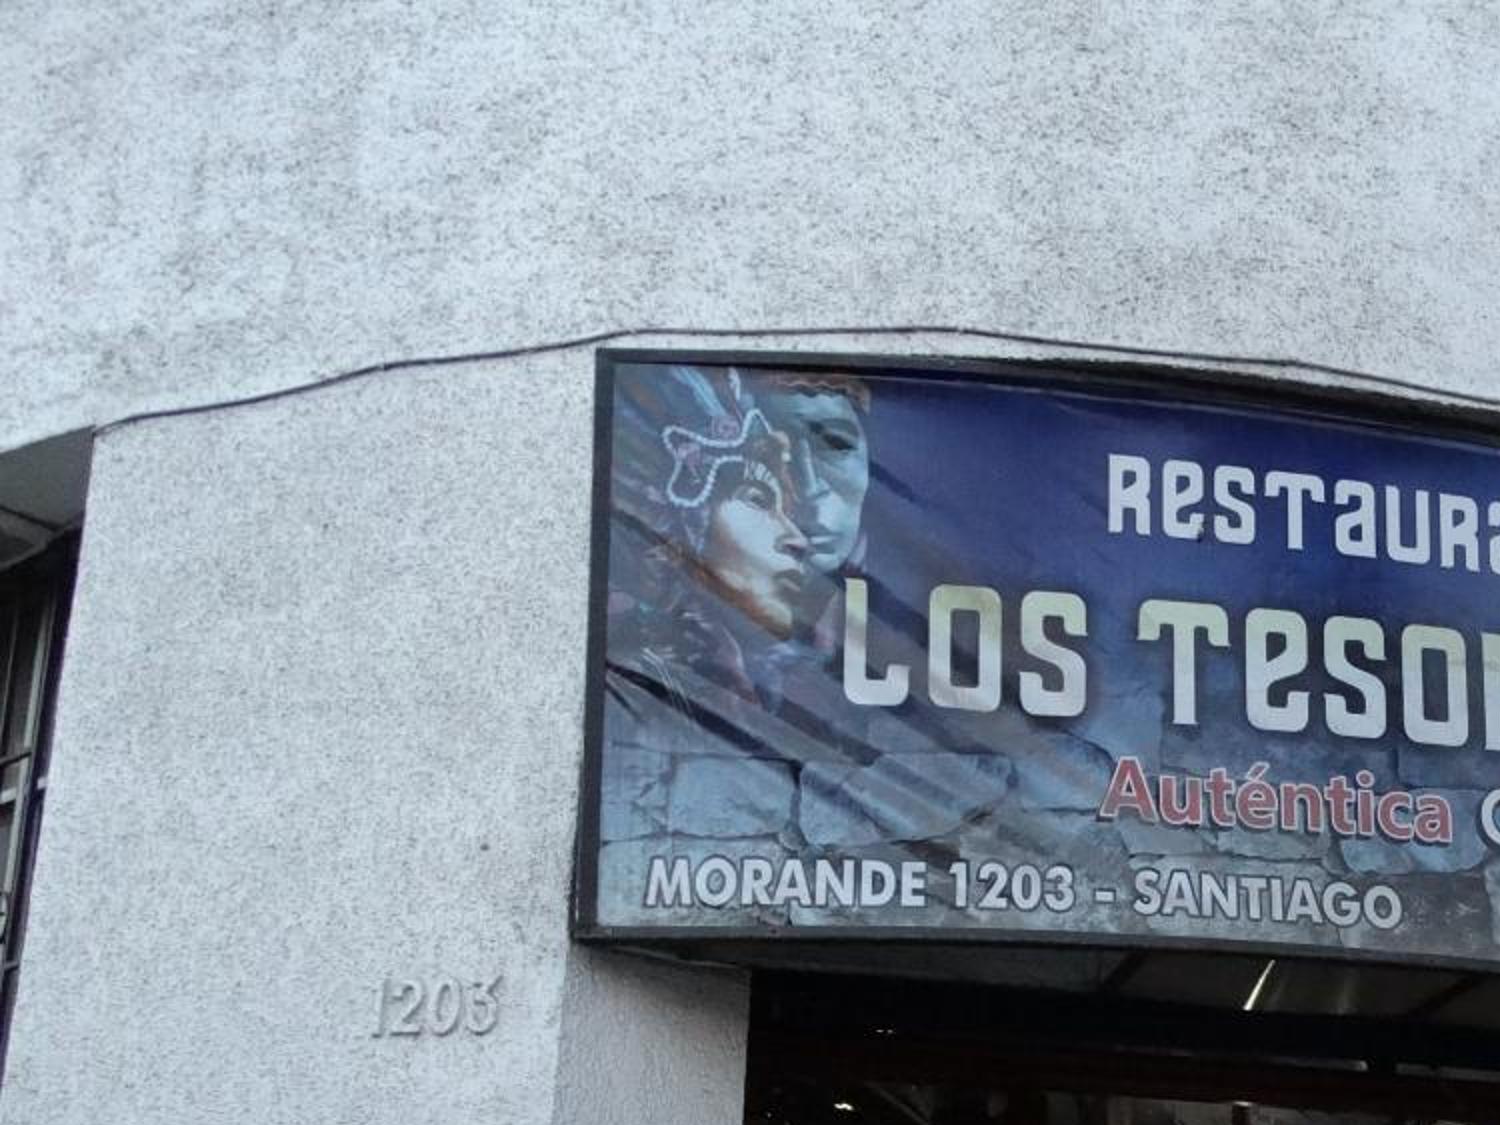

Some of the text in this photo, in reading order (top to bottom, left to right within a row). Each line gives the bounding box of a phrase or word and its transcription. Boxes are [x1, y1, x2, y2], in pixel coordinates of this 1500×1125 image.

[1097, 755, 1455, 844] Auténtica
[643, 857, 926, 908] MORANDE
[948, 861, 1076, 913] 1203
[1134, 869, 1403, 930] SANTIAGO
[371, 977, 503, 1038] 1203
